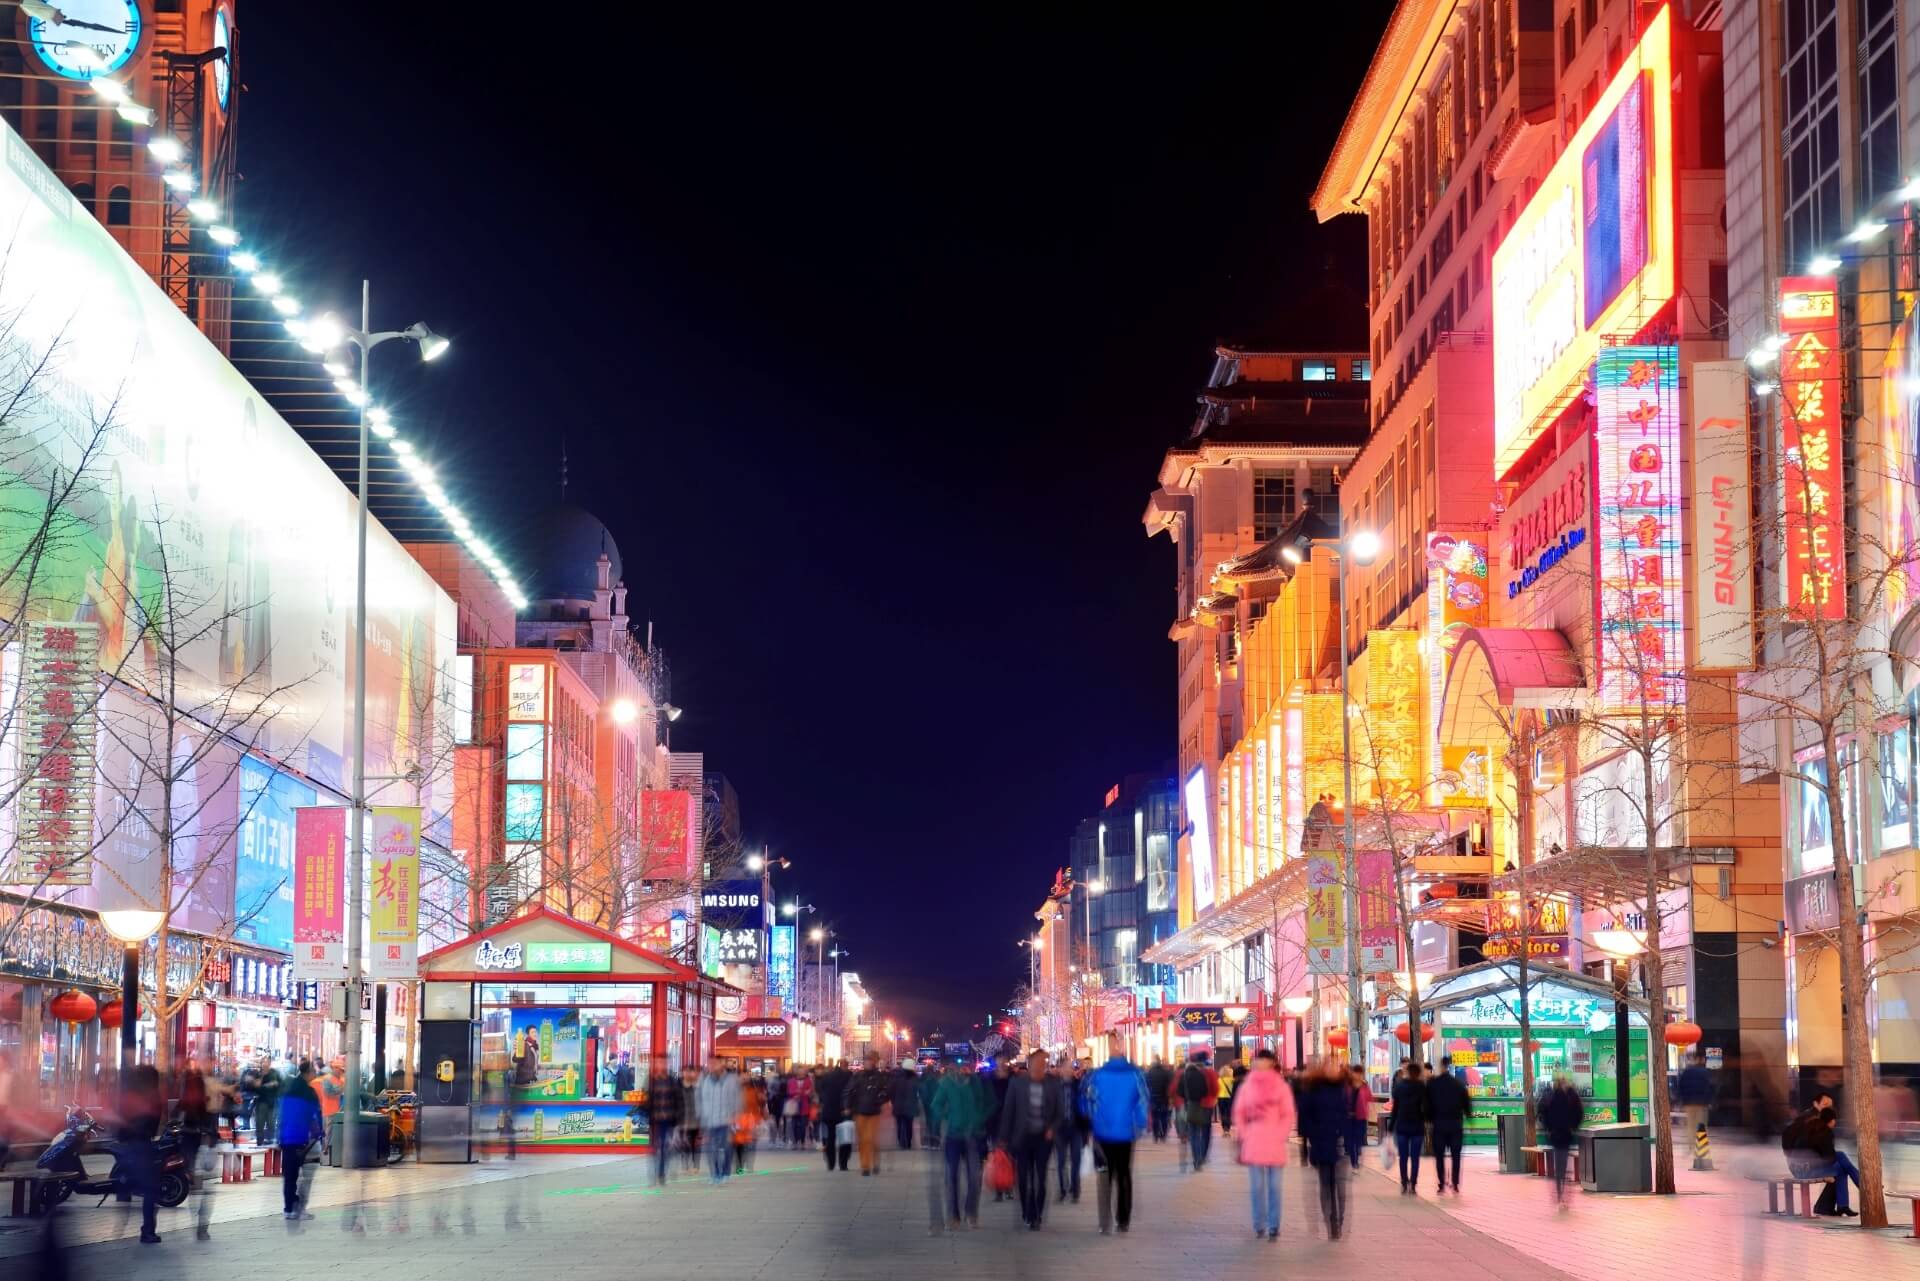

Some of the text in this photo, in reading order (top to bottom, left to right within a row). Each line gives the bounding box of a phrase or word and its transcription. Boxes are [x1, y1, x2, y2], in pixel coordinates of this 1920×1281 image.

[1620, 359, 1668, 702] 新中国儿童用品商店
[1711, 475, 1736, 606] LI-NING
[374, 859, 396, 901] 春
